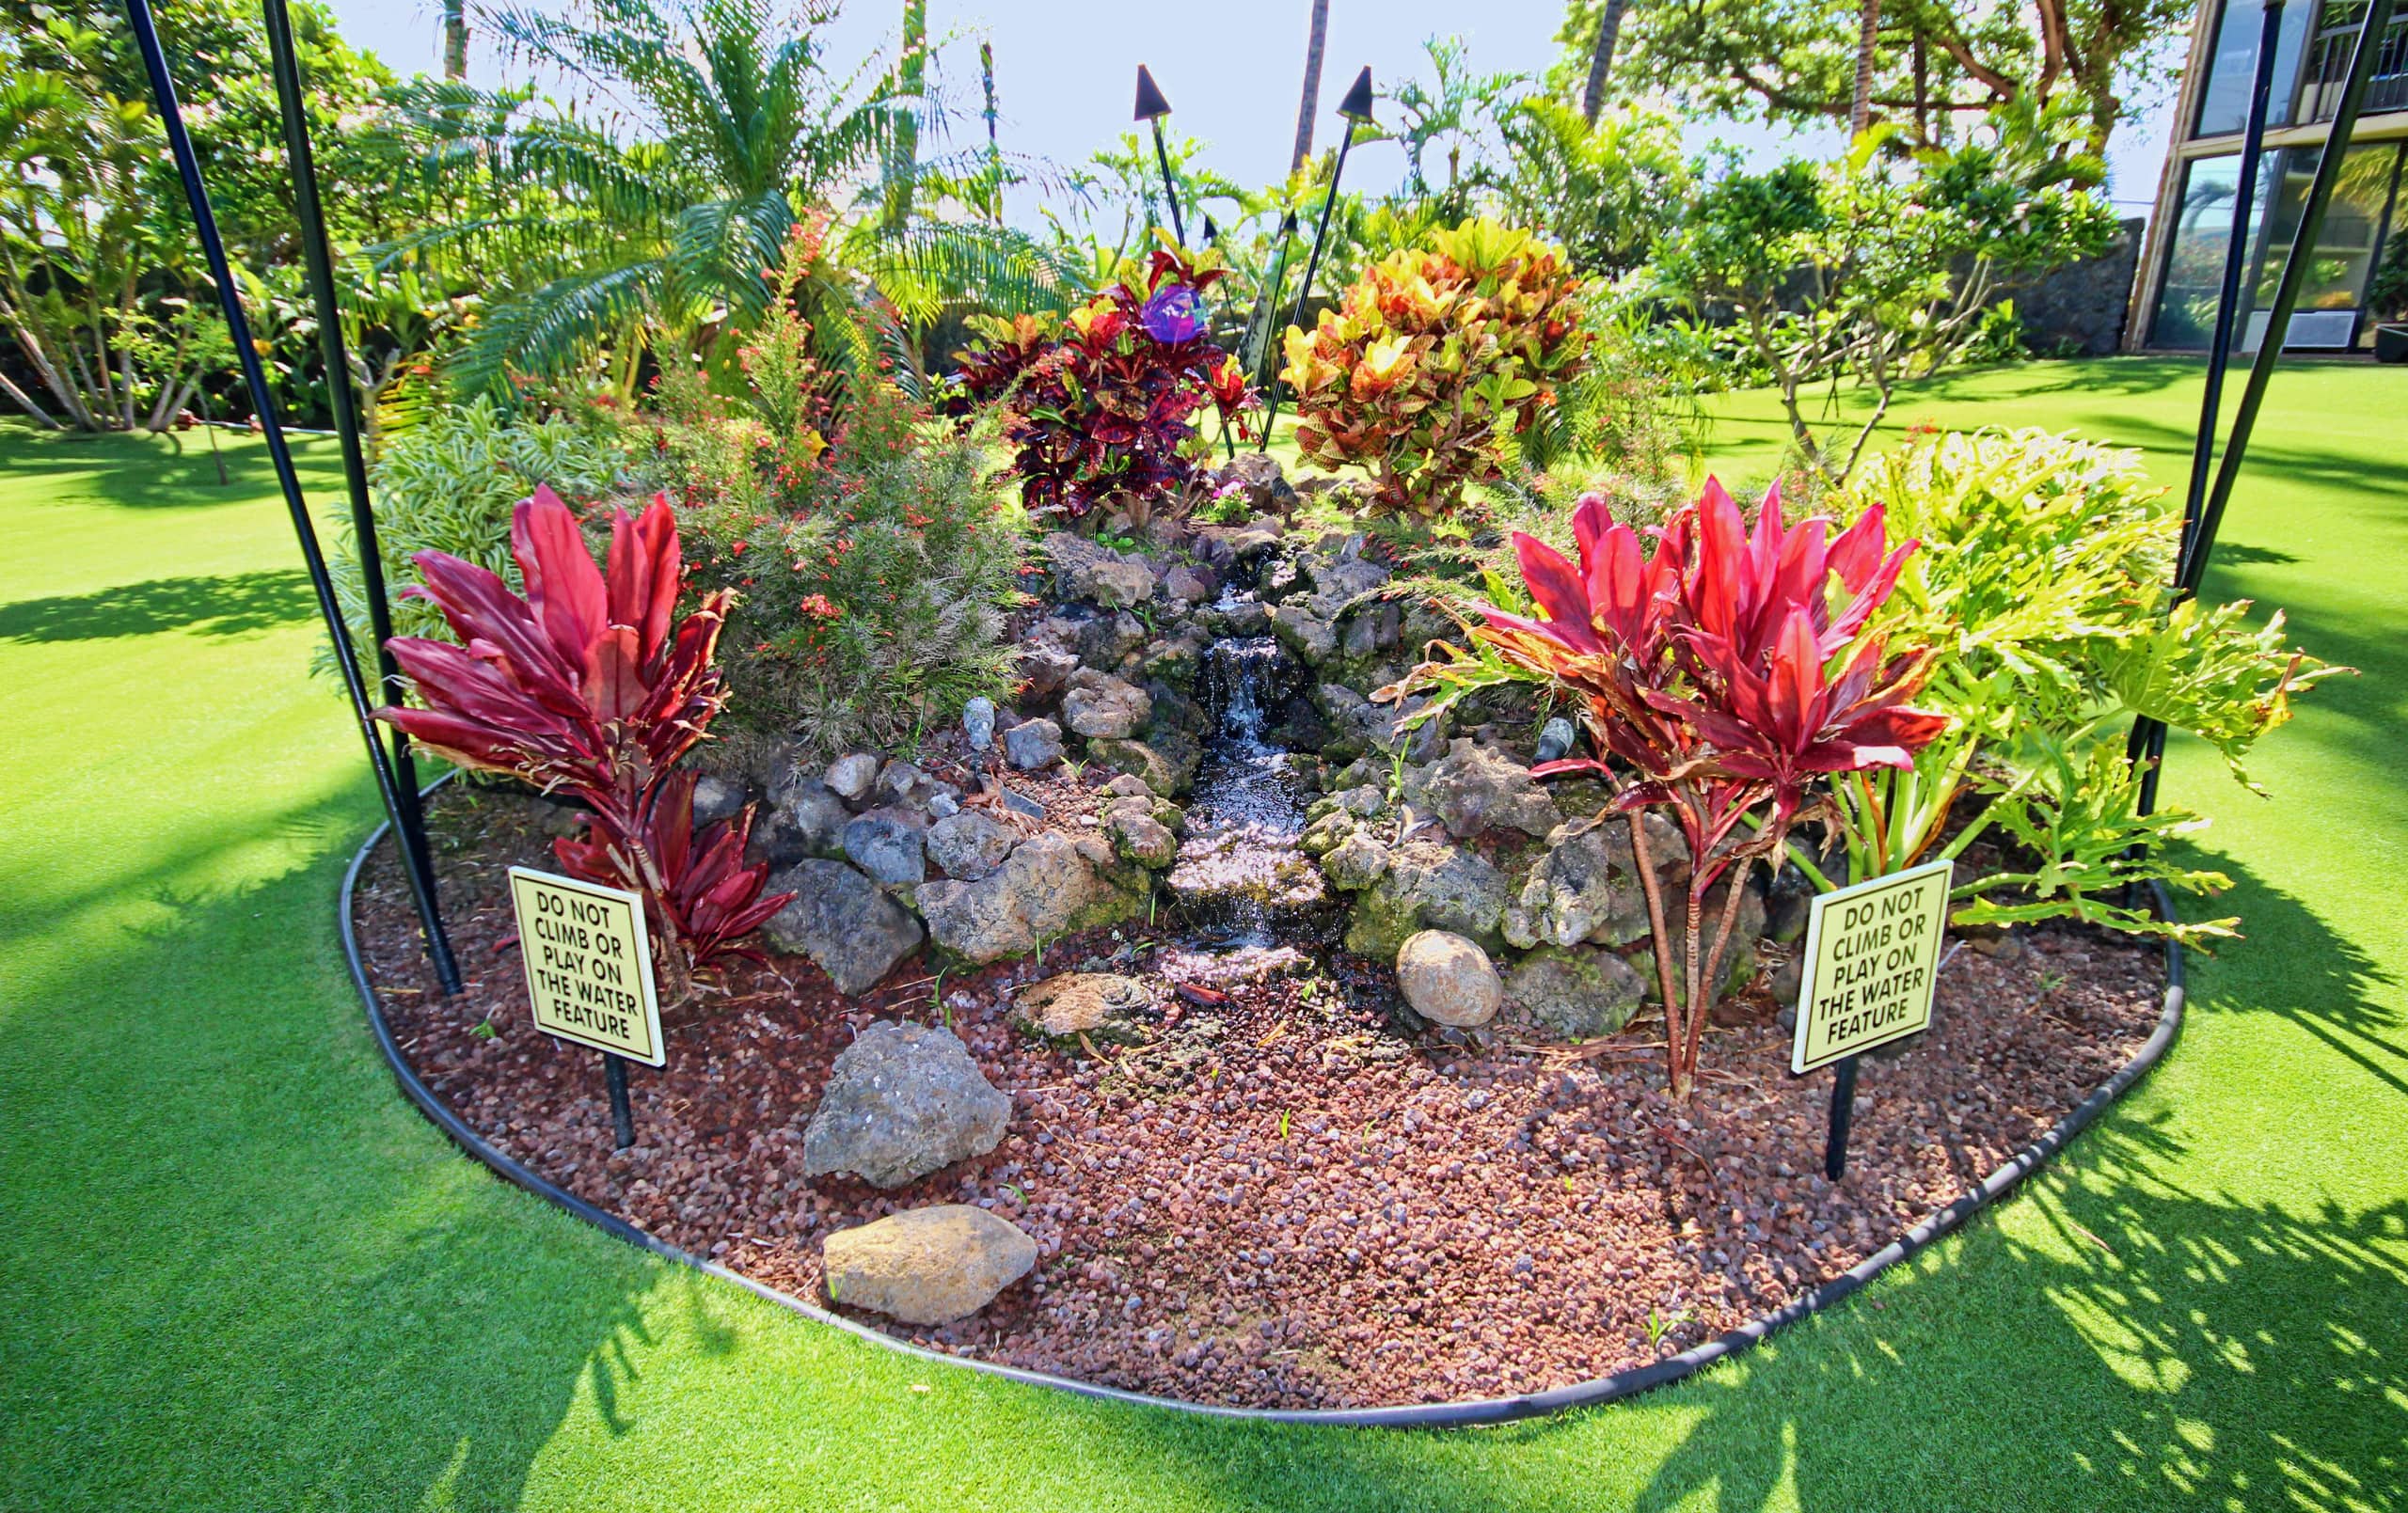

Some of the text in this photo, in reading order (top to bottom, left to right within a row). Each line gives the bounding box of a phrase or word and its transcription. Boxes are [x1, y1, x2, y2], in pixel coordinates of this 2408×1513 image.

[537, 891, 610, 928] DO NOT
[1845, 887, 1924, 931] DO NOT
[535, 918, 623, 959] CLIMB OR
[1833, 914, 1925, 961] CLIMB OR
[544, 945, 622, 985] PLAY ON
[1833, 943, 1917, 989] PLAY ON
[537, 969, 638, 1016] THE WATER
[1820, 968, 1924, 1020] THE WATER
[554, 1000, 630, 1039] FEATURE
[1828, 999, 1909, 1045] FEATURE
